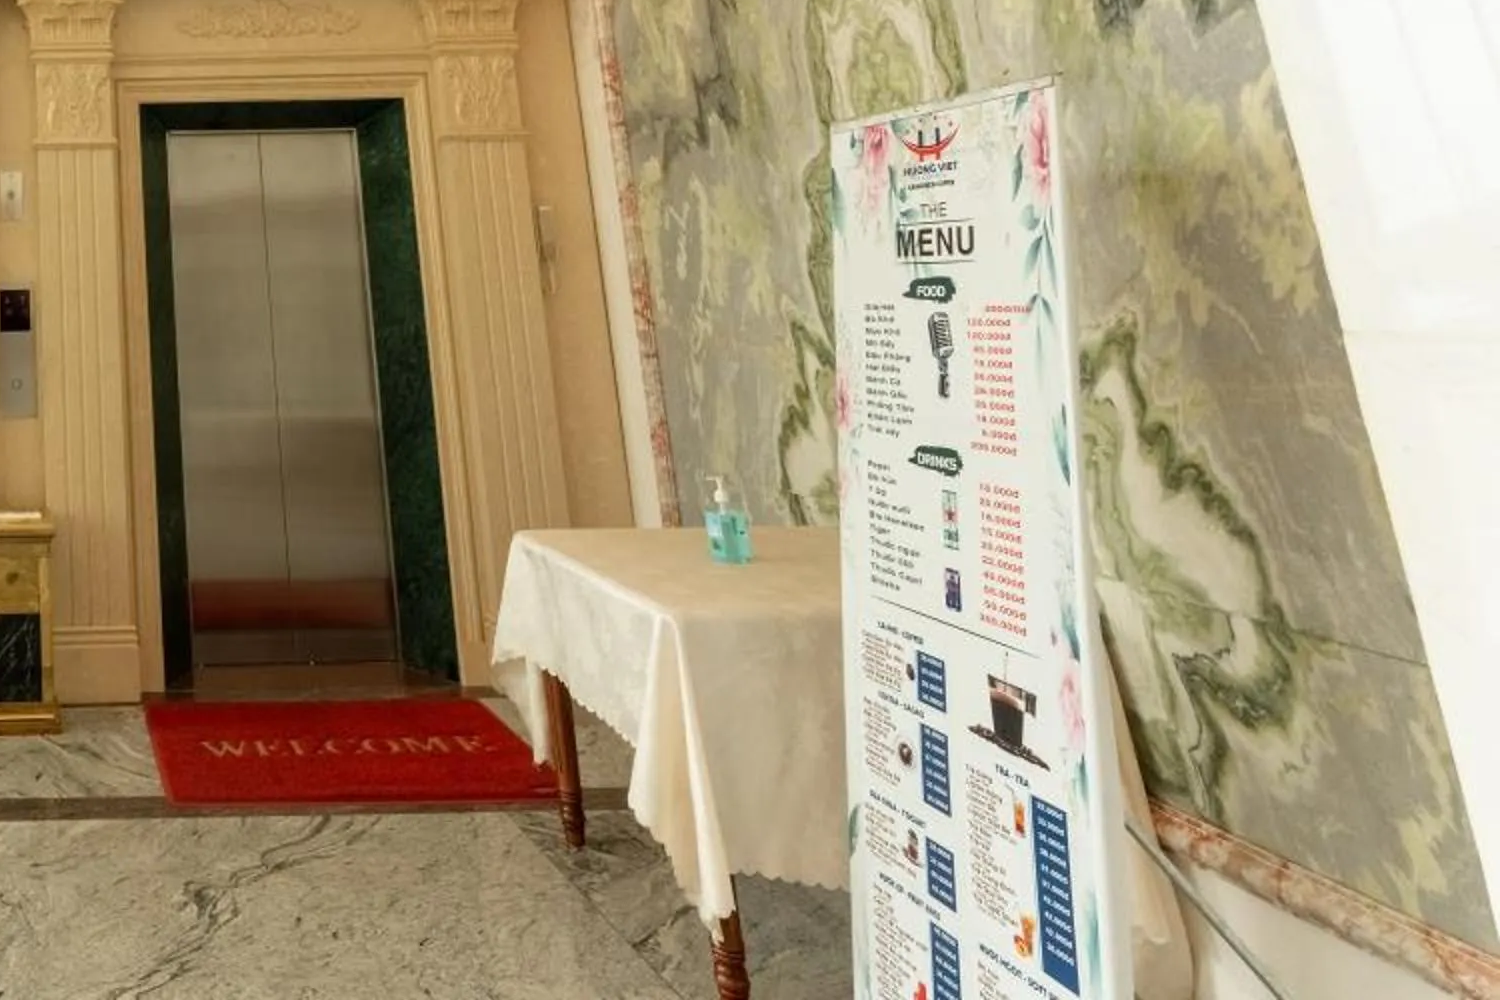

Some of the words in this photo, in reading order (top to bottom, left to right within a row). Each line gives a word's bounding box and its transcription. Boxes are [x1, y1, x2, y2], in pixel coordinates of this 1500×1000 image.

[919, 201, 948, 218] THE
[896, 225, 975, 259] MENU
[915, 284, 947, 298] FOOD
[916, 452, 958, 473] DRINKS
[200, 735, 492, 758] WELCOME
